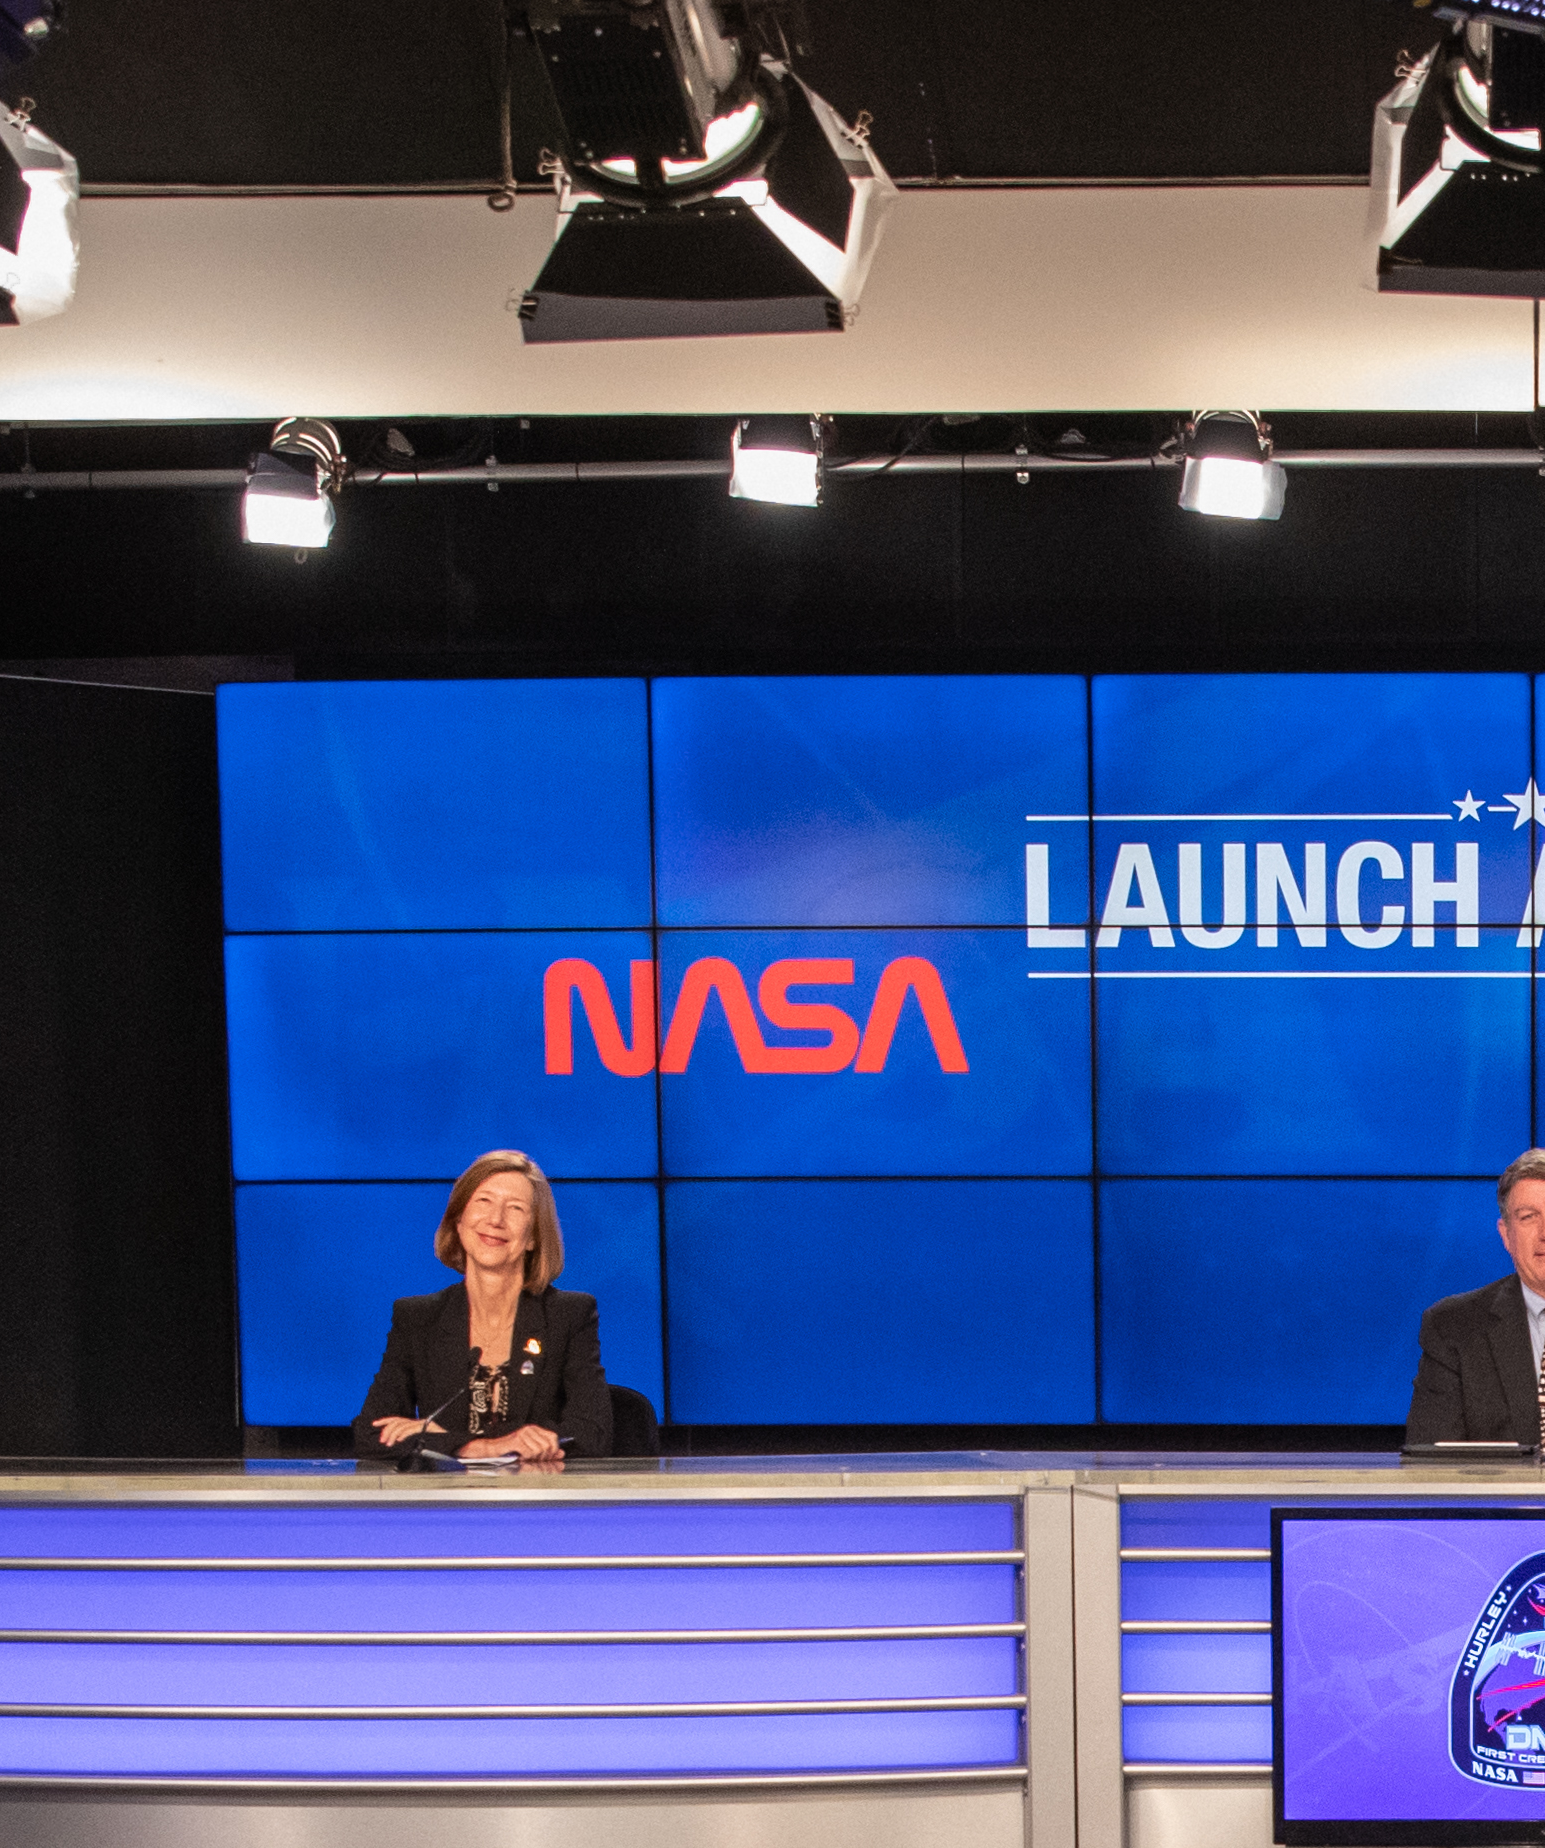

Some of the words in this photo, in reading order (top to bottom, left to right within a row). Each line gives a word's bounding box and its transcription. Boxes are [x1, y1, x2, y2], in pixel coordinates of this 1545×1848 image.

[1026, 841, 1479, 950] LAUNCH
[543, 956, 970, 1077] NASA
[1464, 1591, 1508, 1669] HURLEY
[1472, 1761, 1519, 1783] NASA
[1476, 1745, 1517, 1762] FIRST
